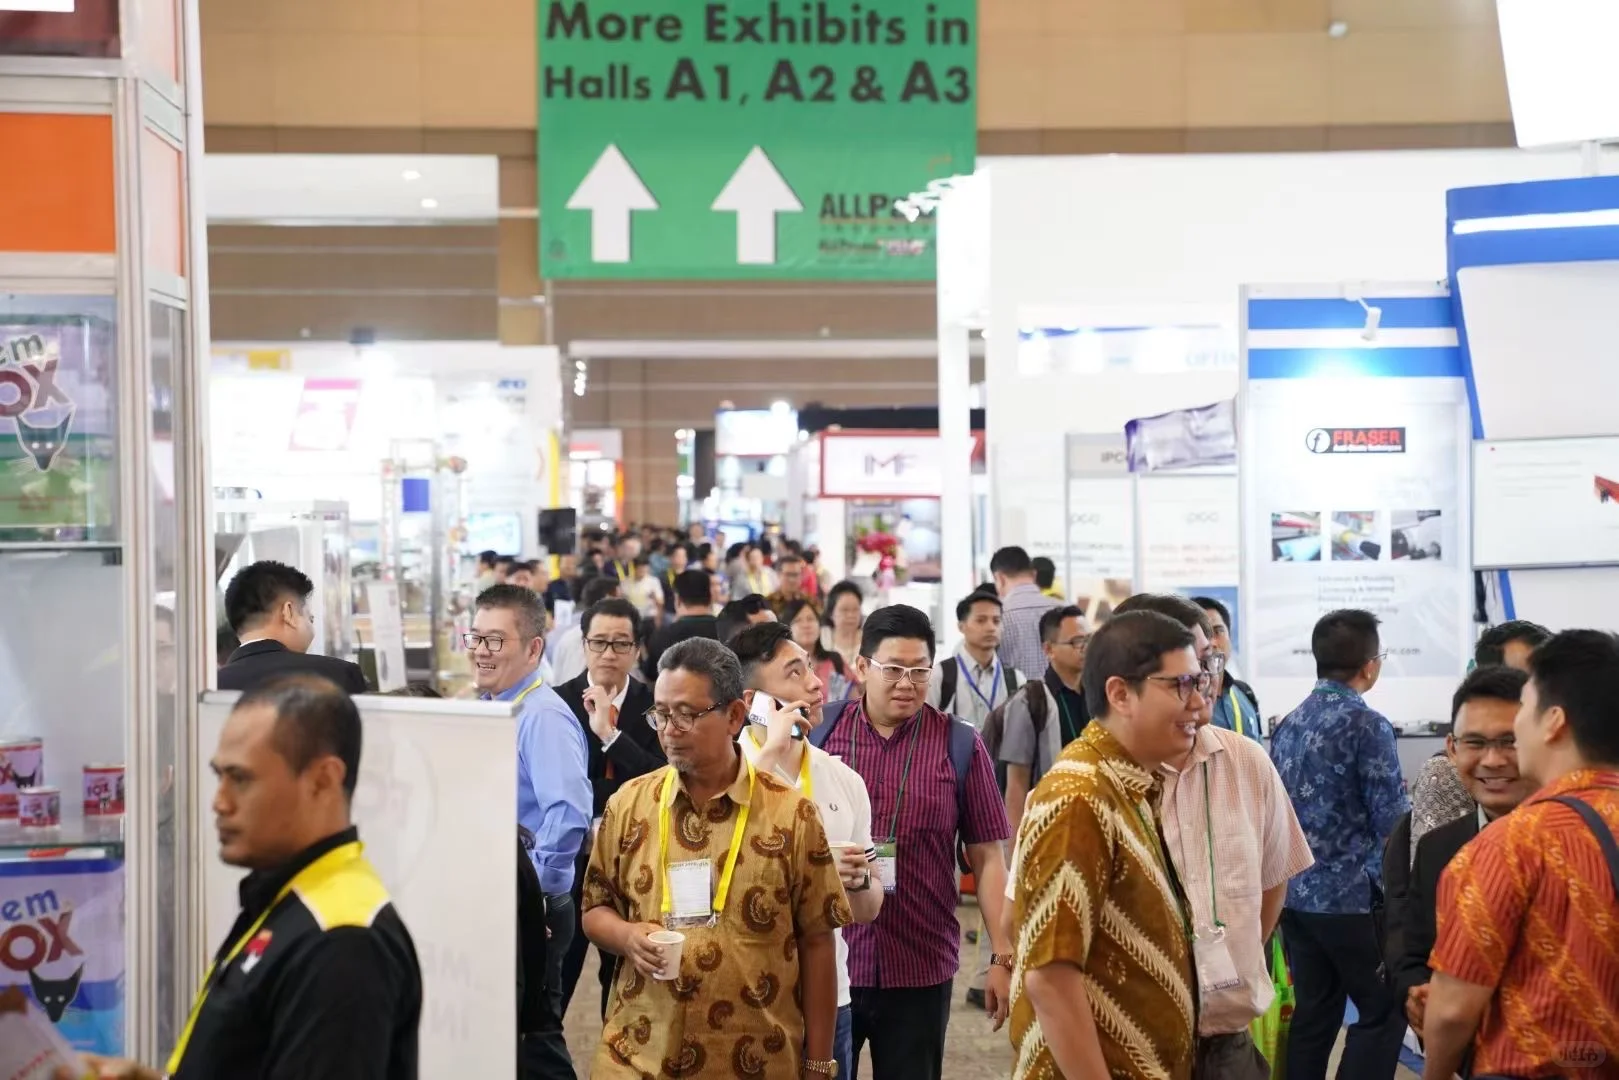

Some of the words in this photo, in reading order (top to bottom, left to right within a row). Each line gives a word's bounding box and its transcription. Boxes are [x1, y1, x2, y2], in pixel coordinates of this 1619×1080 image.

[546, 1, 682, 43] More
[705, 1, 905, 45] Exhibits
[926, 3, 969, 45] in
[545, 63, 651, 99] Halls
[665, 57, 749, 106] A1,
[764, 58, 836, 102] A2
[851, 65, 885, 102] &
[901, 60, 970, 104] A3
[1333, 429, 1400, 446] FRASER
[1, 889, 59, 921] em
